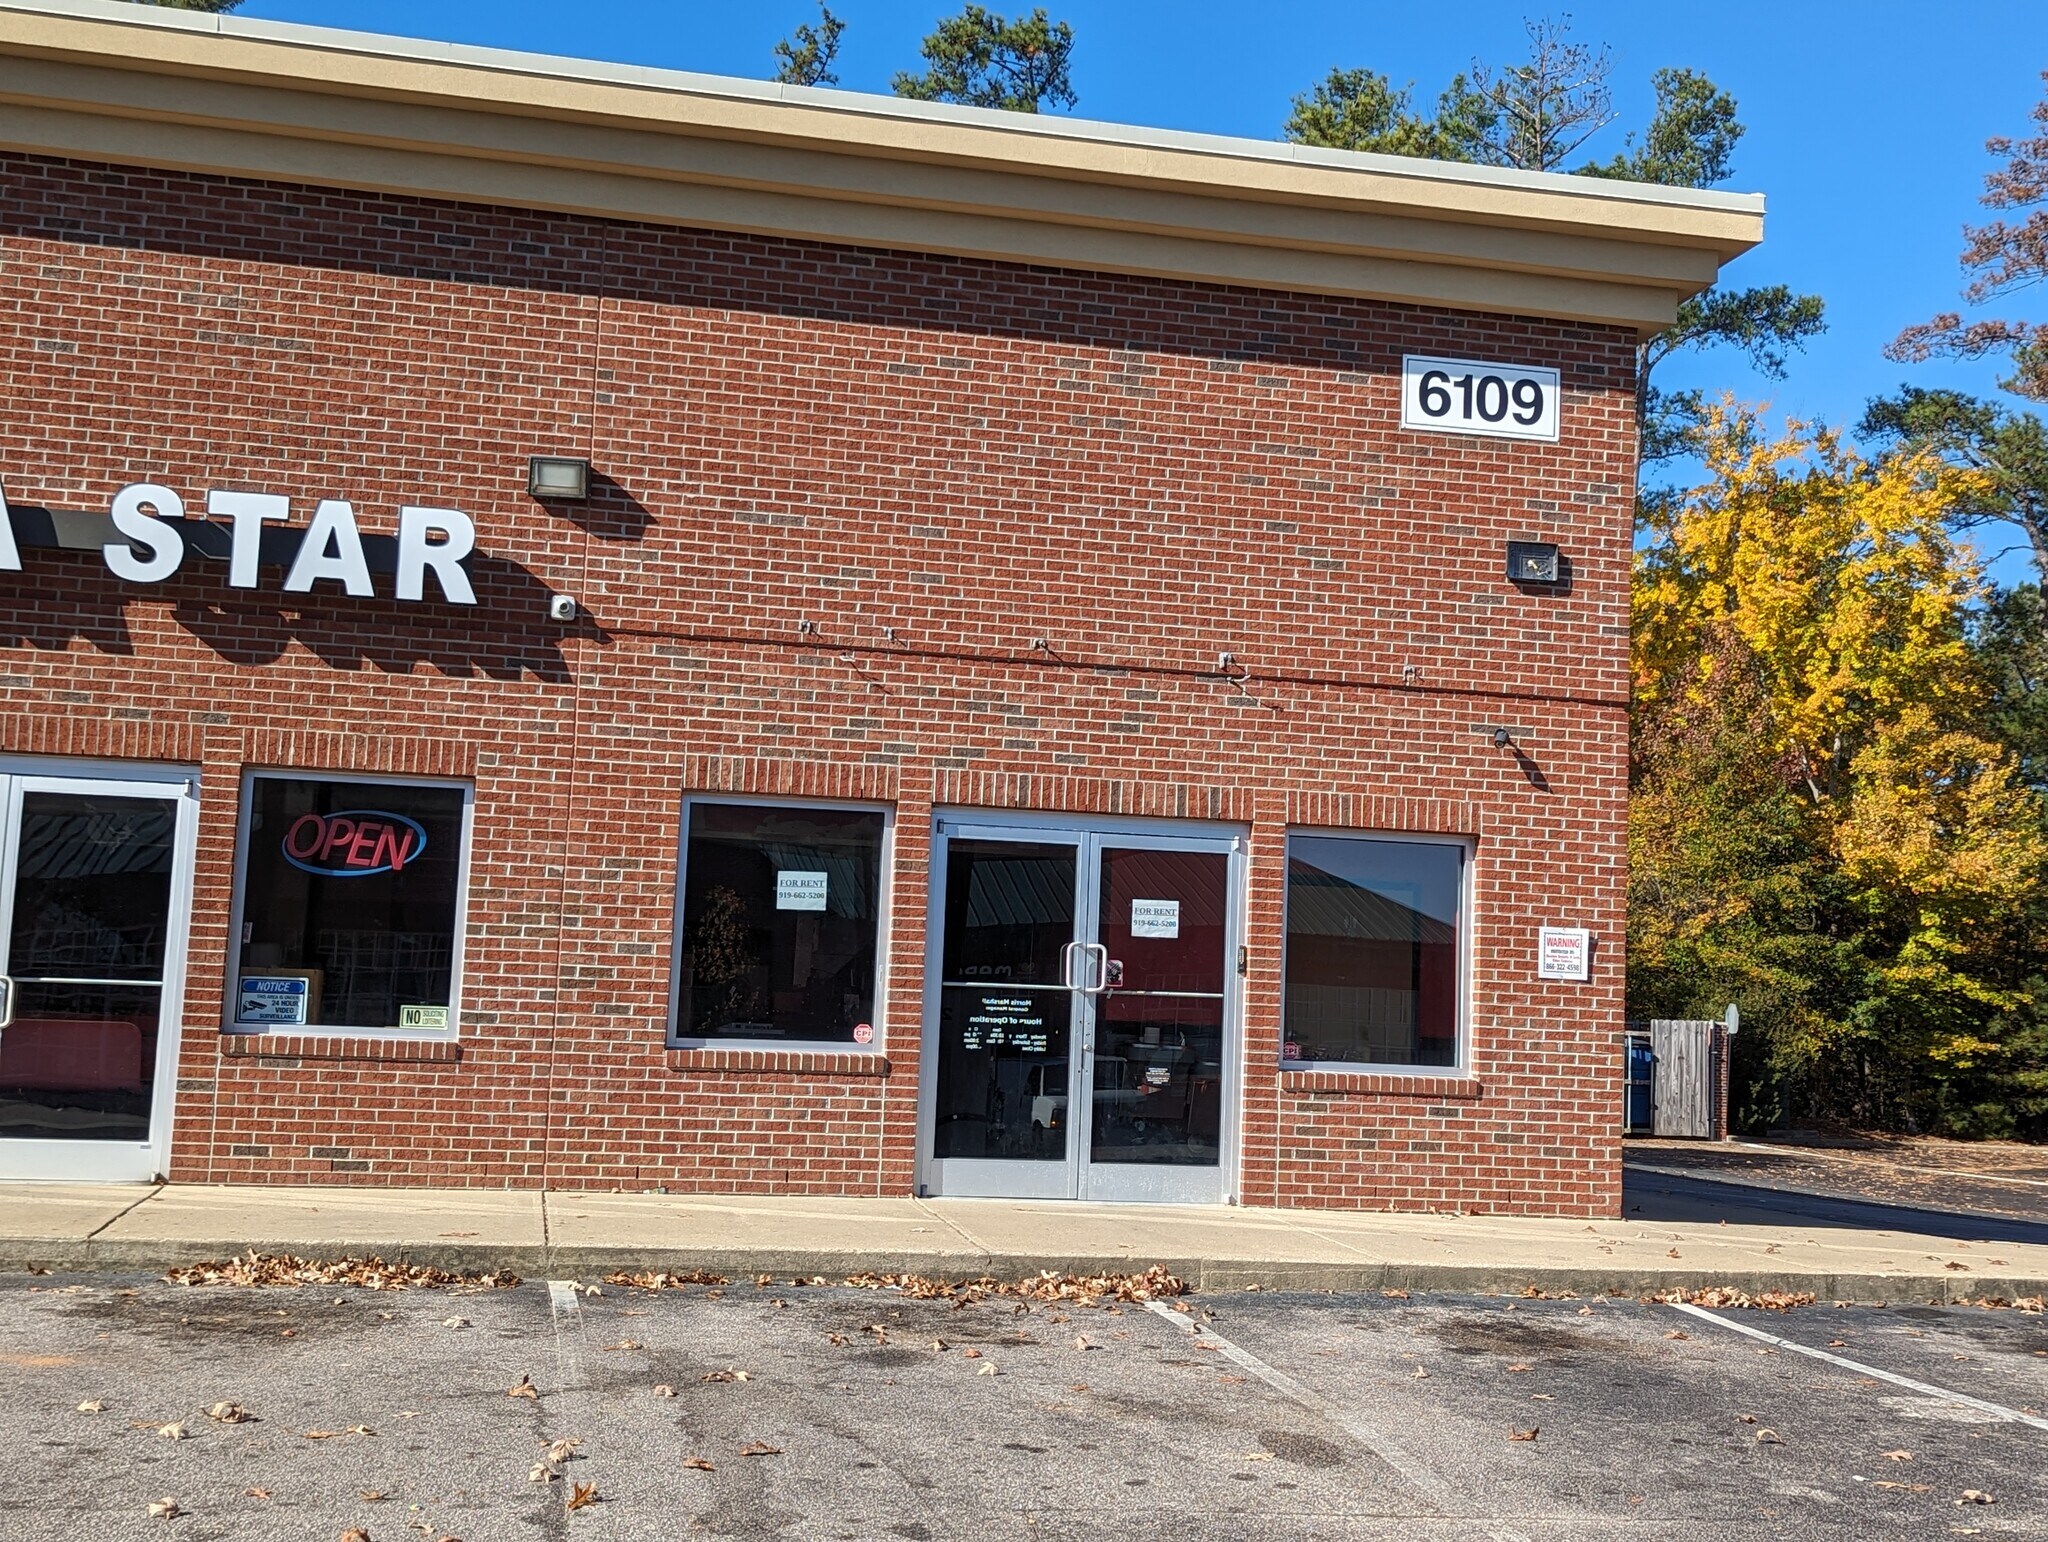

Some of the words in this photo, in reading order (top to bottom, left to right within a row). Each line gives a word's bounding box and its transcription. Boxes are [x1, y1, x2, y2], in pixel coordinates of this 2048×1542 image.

[1418, 369, 1544, 426] 6109
[102, 482, 478, 605] STAR
[286, 813, 415, 871] OPEN
[800, 880, 825, 888] RENT
[778, 891, 825, 899] 919-662-5200
[1134, 907, 1152, 915] FOR
[1153, 908, 1177, 916] RENT
[1133, 919, 1177, 928] 919-662-5200
[1546, 936, 1580, 948] WARNING
[256, 981, 291, 992] NOTICE
[405, 1010, 421, 1024] NO
